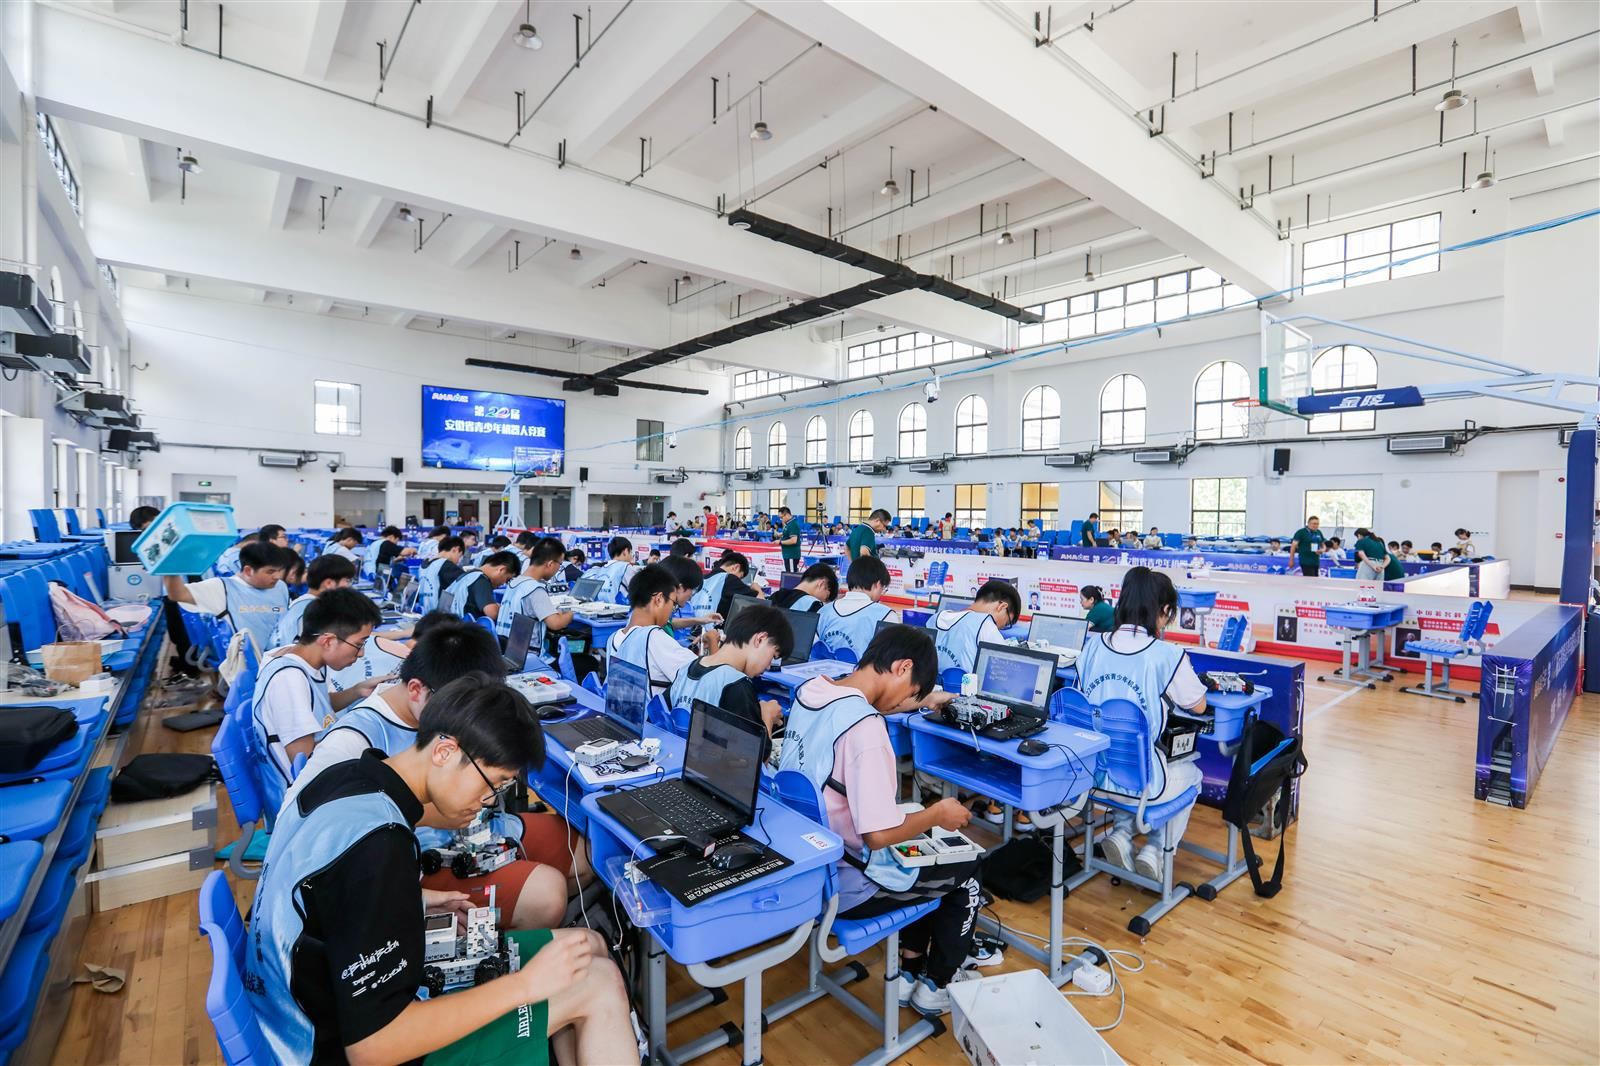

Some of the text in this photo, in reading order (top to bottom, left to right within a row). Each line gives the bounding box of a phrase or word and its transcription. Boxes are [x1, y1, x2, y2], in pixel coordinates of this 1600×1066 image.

[444, 419, 546, 438] 安徽省青少年机器人竞赛
